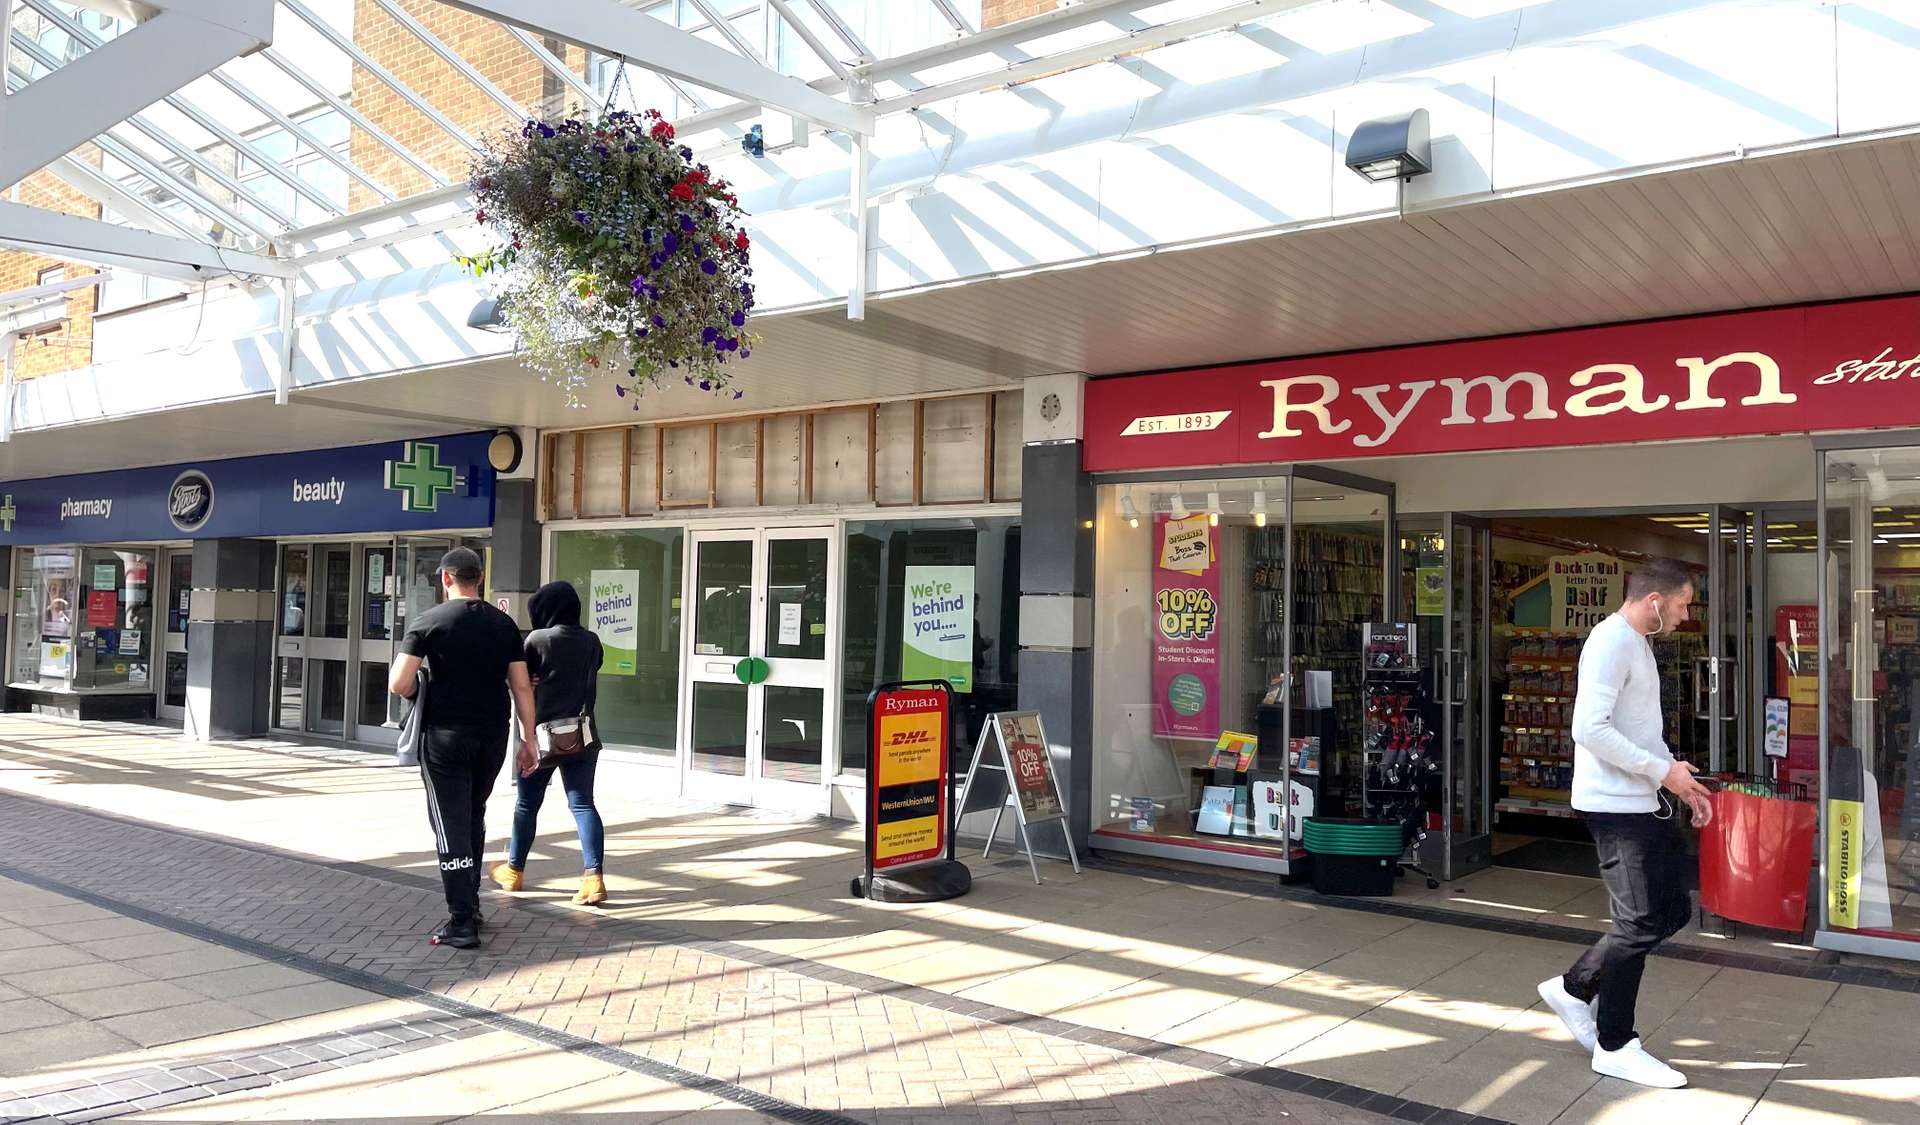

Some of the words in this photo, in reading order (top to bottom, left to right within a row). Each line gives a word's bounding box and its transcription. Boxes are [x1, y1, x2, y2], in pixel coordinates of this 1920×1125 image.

[1813, 346, 1920, 385] stat
[1258, 351, 1797, 447] Ryman
[1138, 419, 1168, 432] EST.
[1177, 414, 1212, 430] 1893
[170, 484, 203, 516] Boots
[293, 477, 345, 504] beauty
[60, 497, 112, 520] pharmacy
[1554, 560, 1582, 574] Back
[1583, 562, 1594, 573] To
[1597, 561, 1618, 575] Uni
[594, 582, 624, 598] We're
[911, 580, 952, 599] We're
[1566, 586, 1608, 606] Half
[595, 594, 632, 613] behind
[912, 594, 964, 617] behind
[1158, 588, 1218, 613] 10%
[1159, 612, 1215, 641] OFF
[1565, 607, 1607, 627] Price
[1371, 633, 1408, 641] raindrops
[1158, 646, 1185, 654] Student
[1185, 646, 1215, 655] Discount
[1158, 655, 1185, 663] In-Store
[1193, 656, 1215, 664] Online
[885, 697, 939, 712] Ryman
[891, 730, 929, 746] DHL
[1016, 748, 1038, 763] 10%
[1020, 761, 1041, 777] OFF
[1266, 786, 1300, 806] Bak
[440, 855, 474, 871] adida
[1839, 829, 1850, 880] STABILO
[1838, 881, 1850, 914] BOSS
